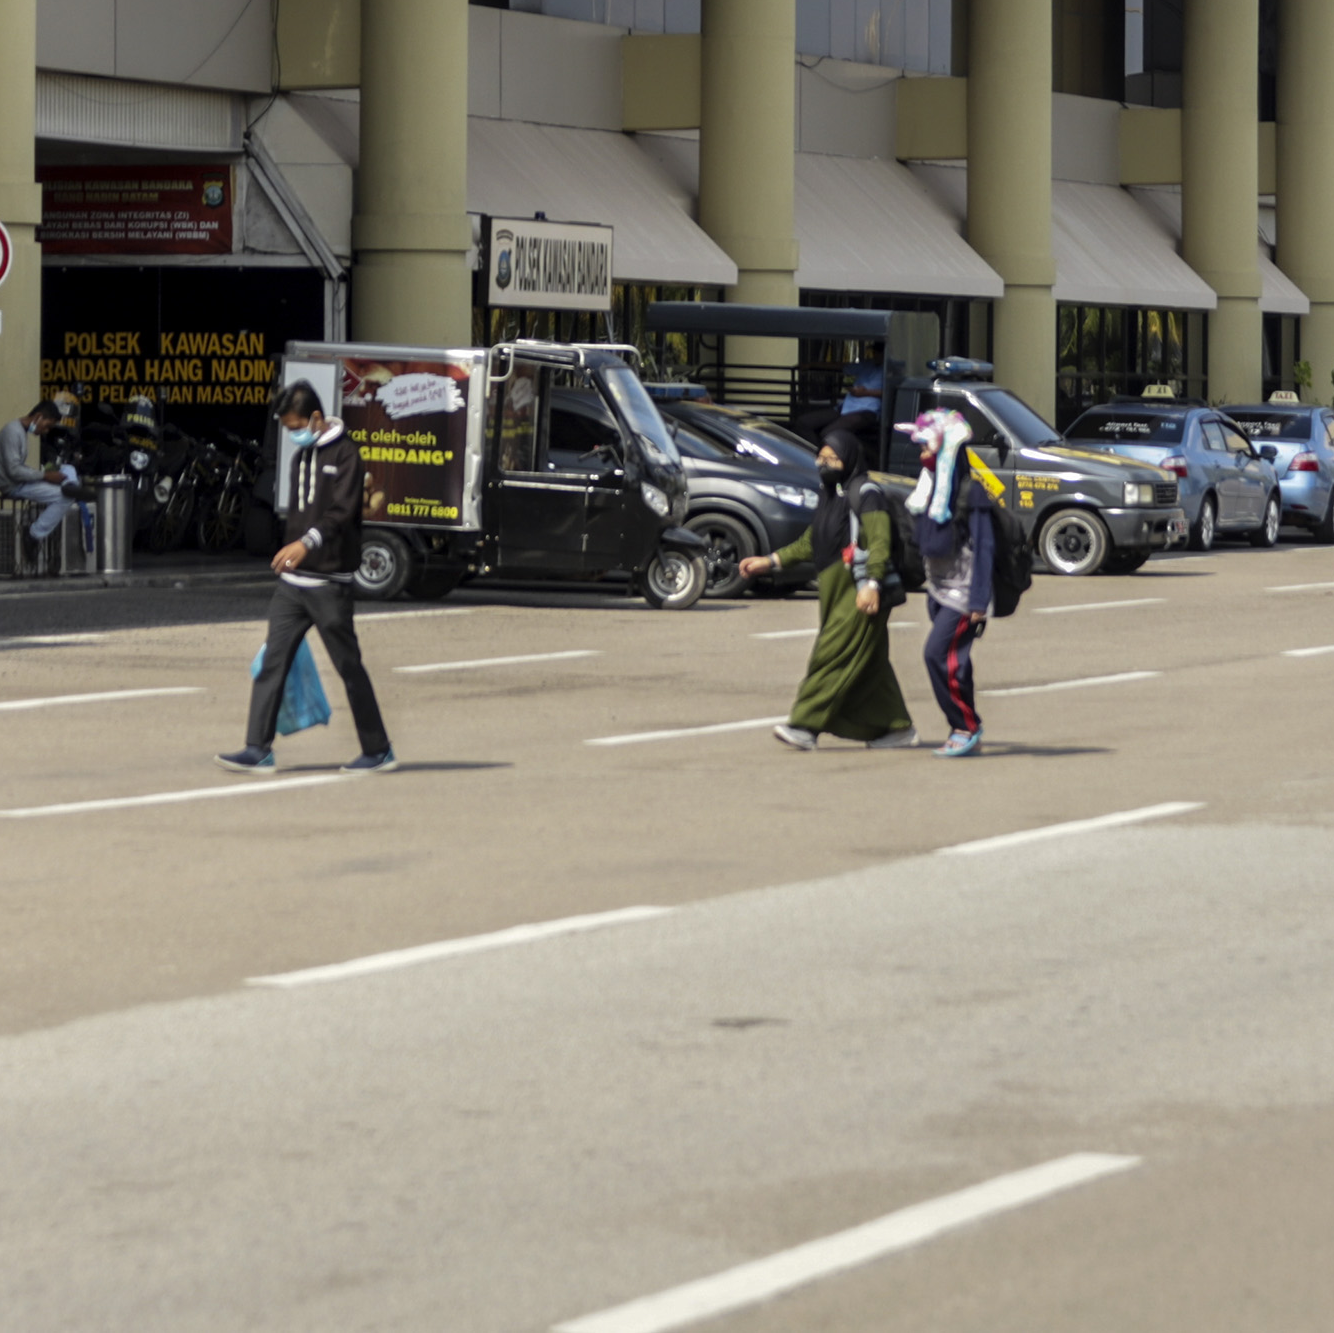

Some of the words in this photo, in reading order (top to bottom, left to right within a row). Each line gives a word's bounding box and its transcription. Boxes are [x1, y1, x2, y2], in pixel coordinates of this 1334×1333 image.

[118, 211, 172, 219] INTEGRITAS
[174, 211, 190, 220] (ZI)
[104, 221, 125, 229] DARI
[128, 221, 168, 229] KORUPSI
[199, 221, 219, 229] DAN
[128, 231, 173, 239] MELAYANI
[65, 332, 141, 355] POLSEK
[160, 332, 265, 356] KAWASAN
[41, 359, 138, 382] BANDARA
[145, 360, 203, 382] HANG
[211, 360, 275, 382] NADIM
[1274, 391, 1293, 400] TAXI
[371, 429, 437, 446] oleh-oleh
[387, 503, 411, 515] 0811
[412, 505, 430, 517] 777
[431, 506, 458, 519] 6800
